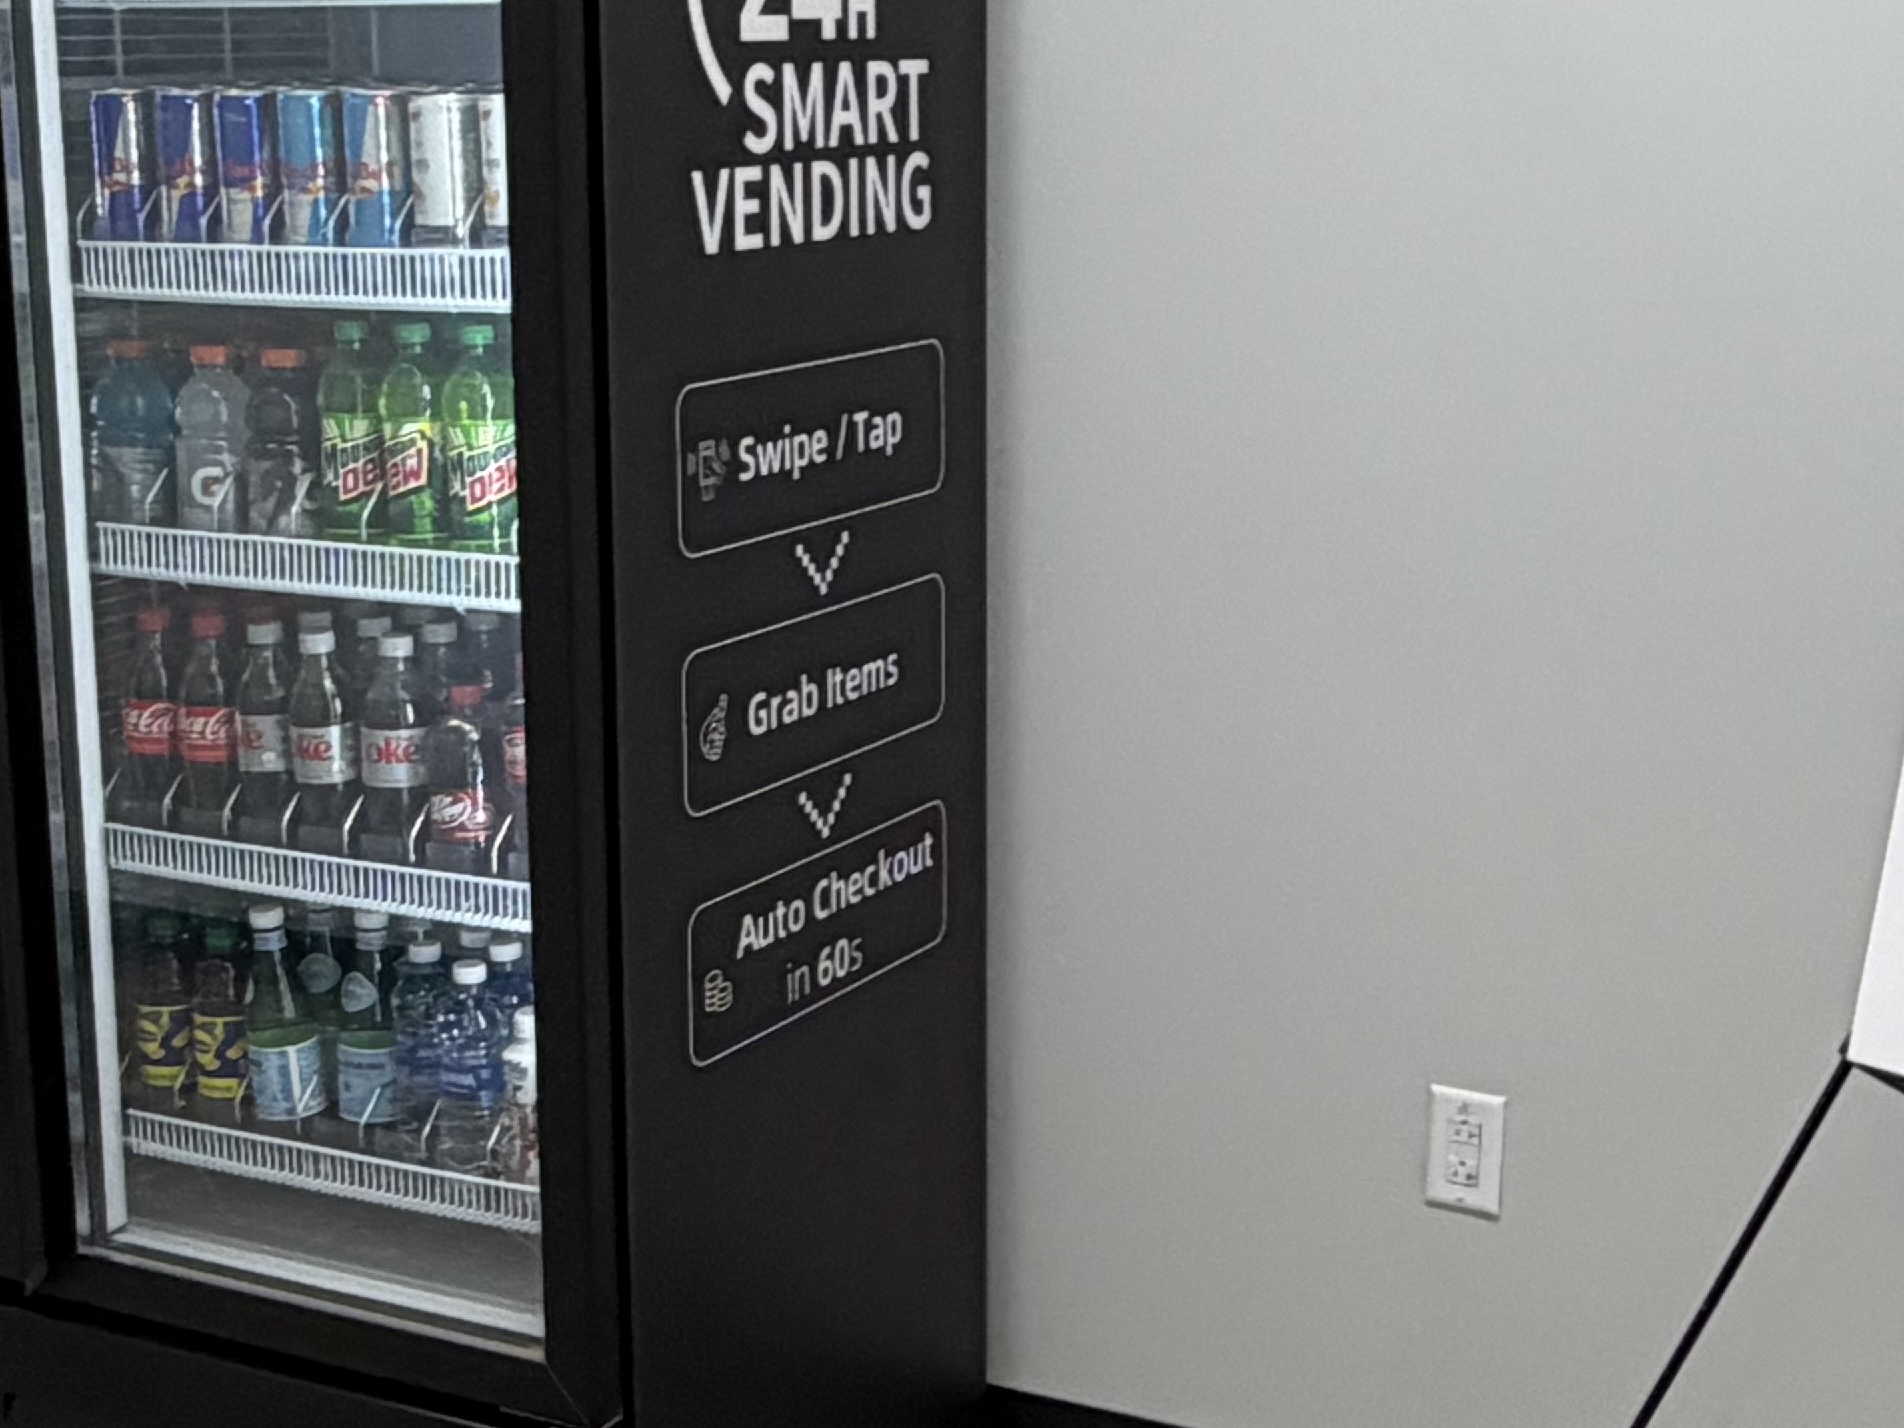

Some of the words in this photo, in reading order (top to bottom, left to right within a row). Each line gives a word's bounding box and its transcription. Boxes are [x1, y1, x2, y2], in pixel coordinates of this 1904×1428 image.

[742, 59, 929, 154] SMART
[691, 151, 932, 256] VENDING
[737, 424, 829, 482] Swipe
[835, 412, 850, 460] /
[853, 410, 903, 460] Tap
[747, 675, 819, 738] Grab
[826, 650, 900, 709] Items
[735, 897, 806, 960] Auto
[813, 829, 936, 921] Checkout
[785, 962, 811, 1006] in
[817, 933, 864, 988] 60s
